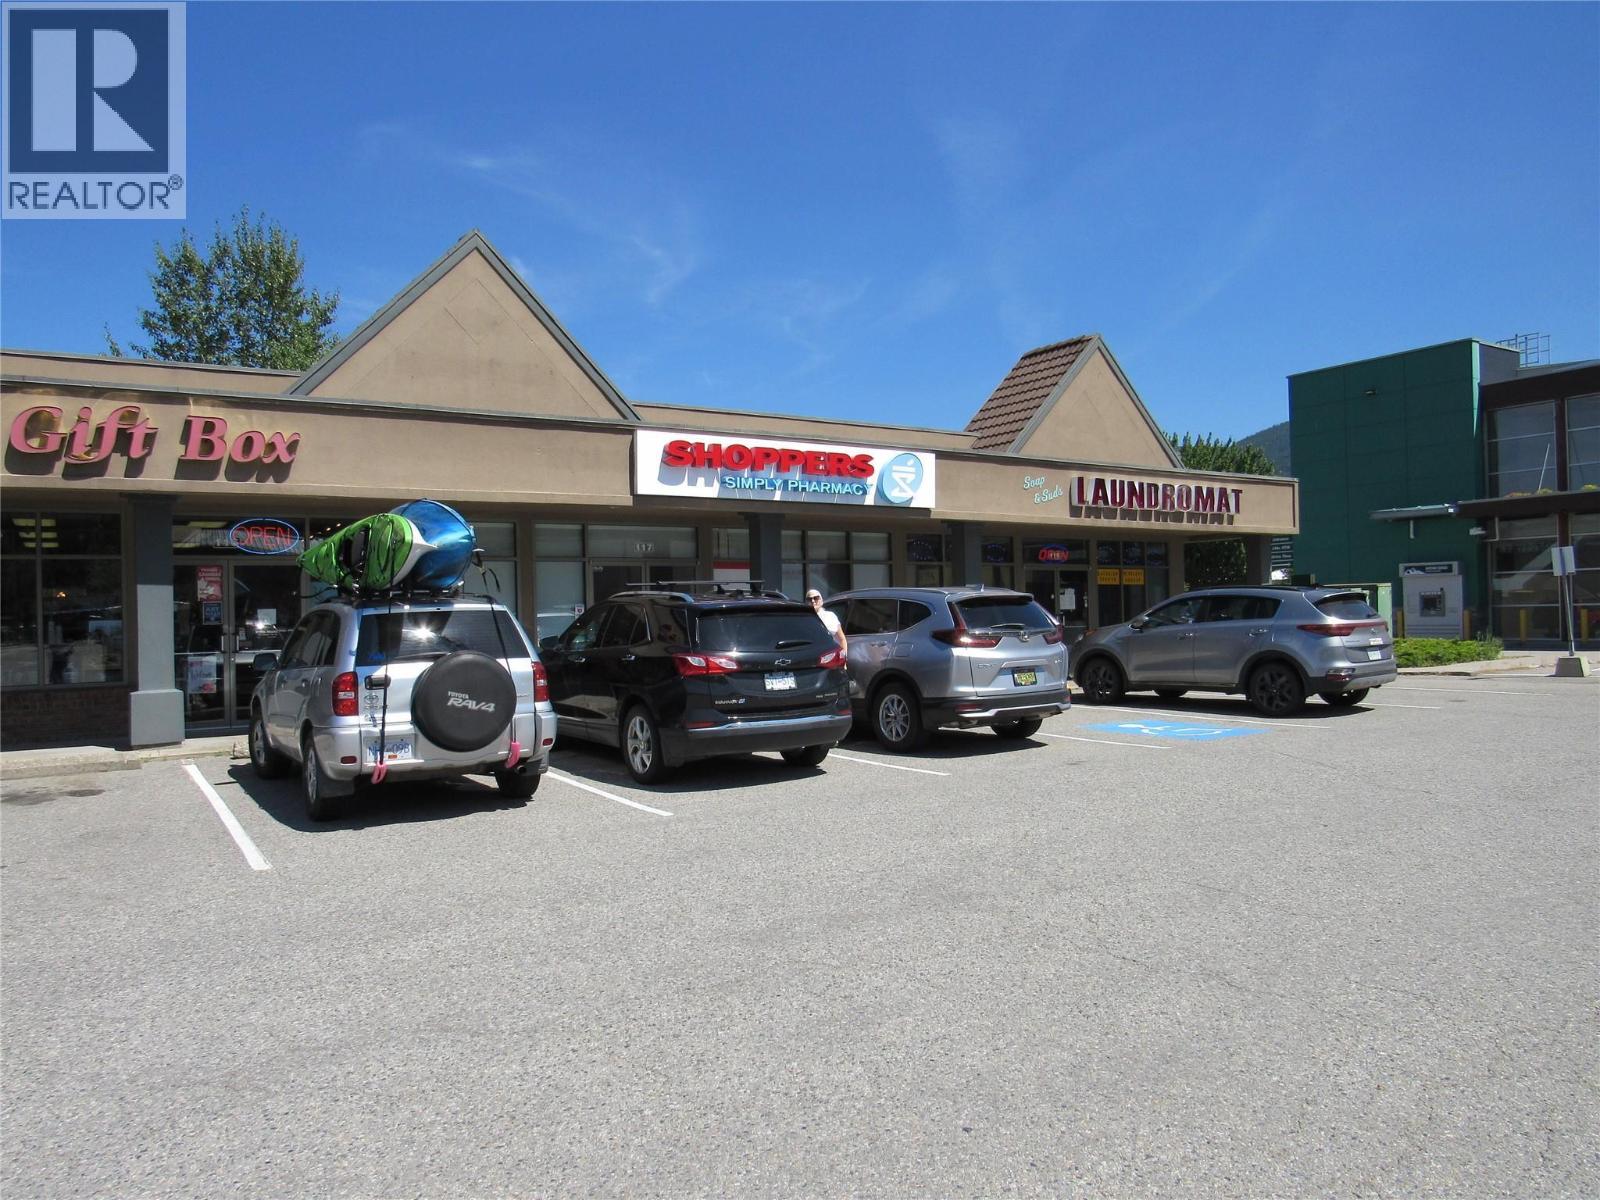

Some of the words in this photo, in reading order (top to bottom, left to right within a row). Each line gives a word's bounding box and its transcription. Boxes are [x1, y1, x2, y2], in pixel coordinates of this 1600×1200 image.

[10, 406, 159, 464] Gift
[181, 415, 301, 464] Box
[663, 440, 875, 478] SHOPPERS
[724, 476, 783, 493] SIMPLY
[788, 478, 872, 496] PHARMACY
[1023, 476, 1045, 489] Soap
[1072, 476, 1243, 514] LAUNDROMAT
[232, 526, 292, 546] OPEN
[447, 697, 496, 712] RAV4
[448, 690, 470, 699] TOYOTA
